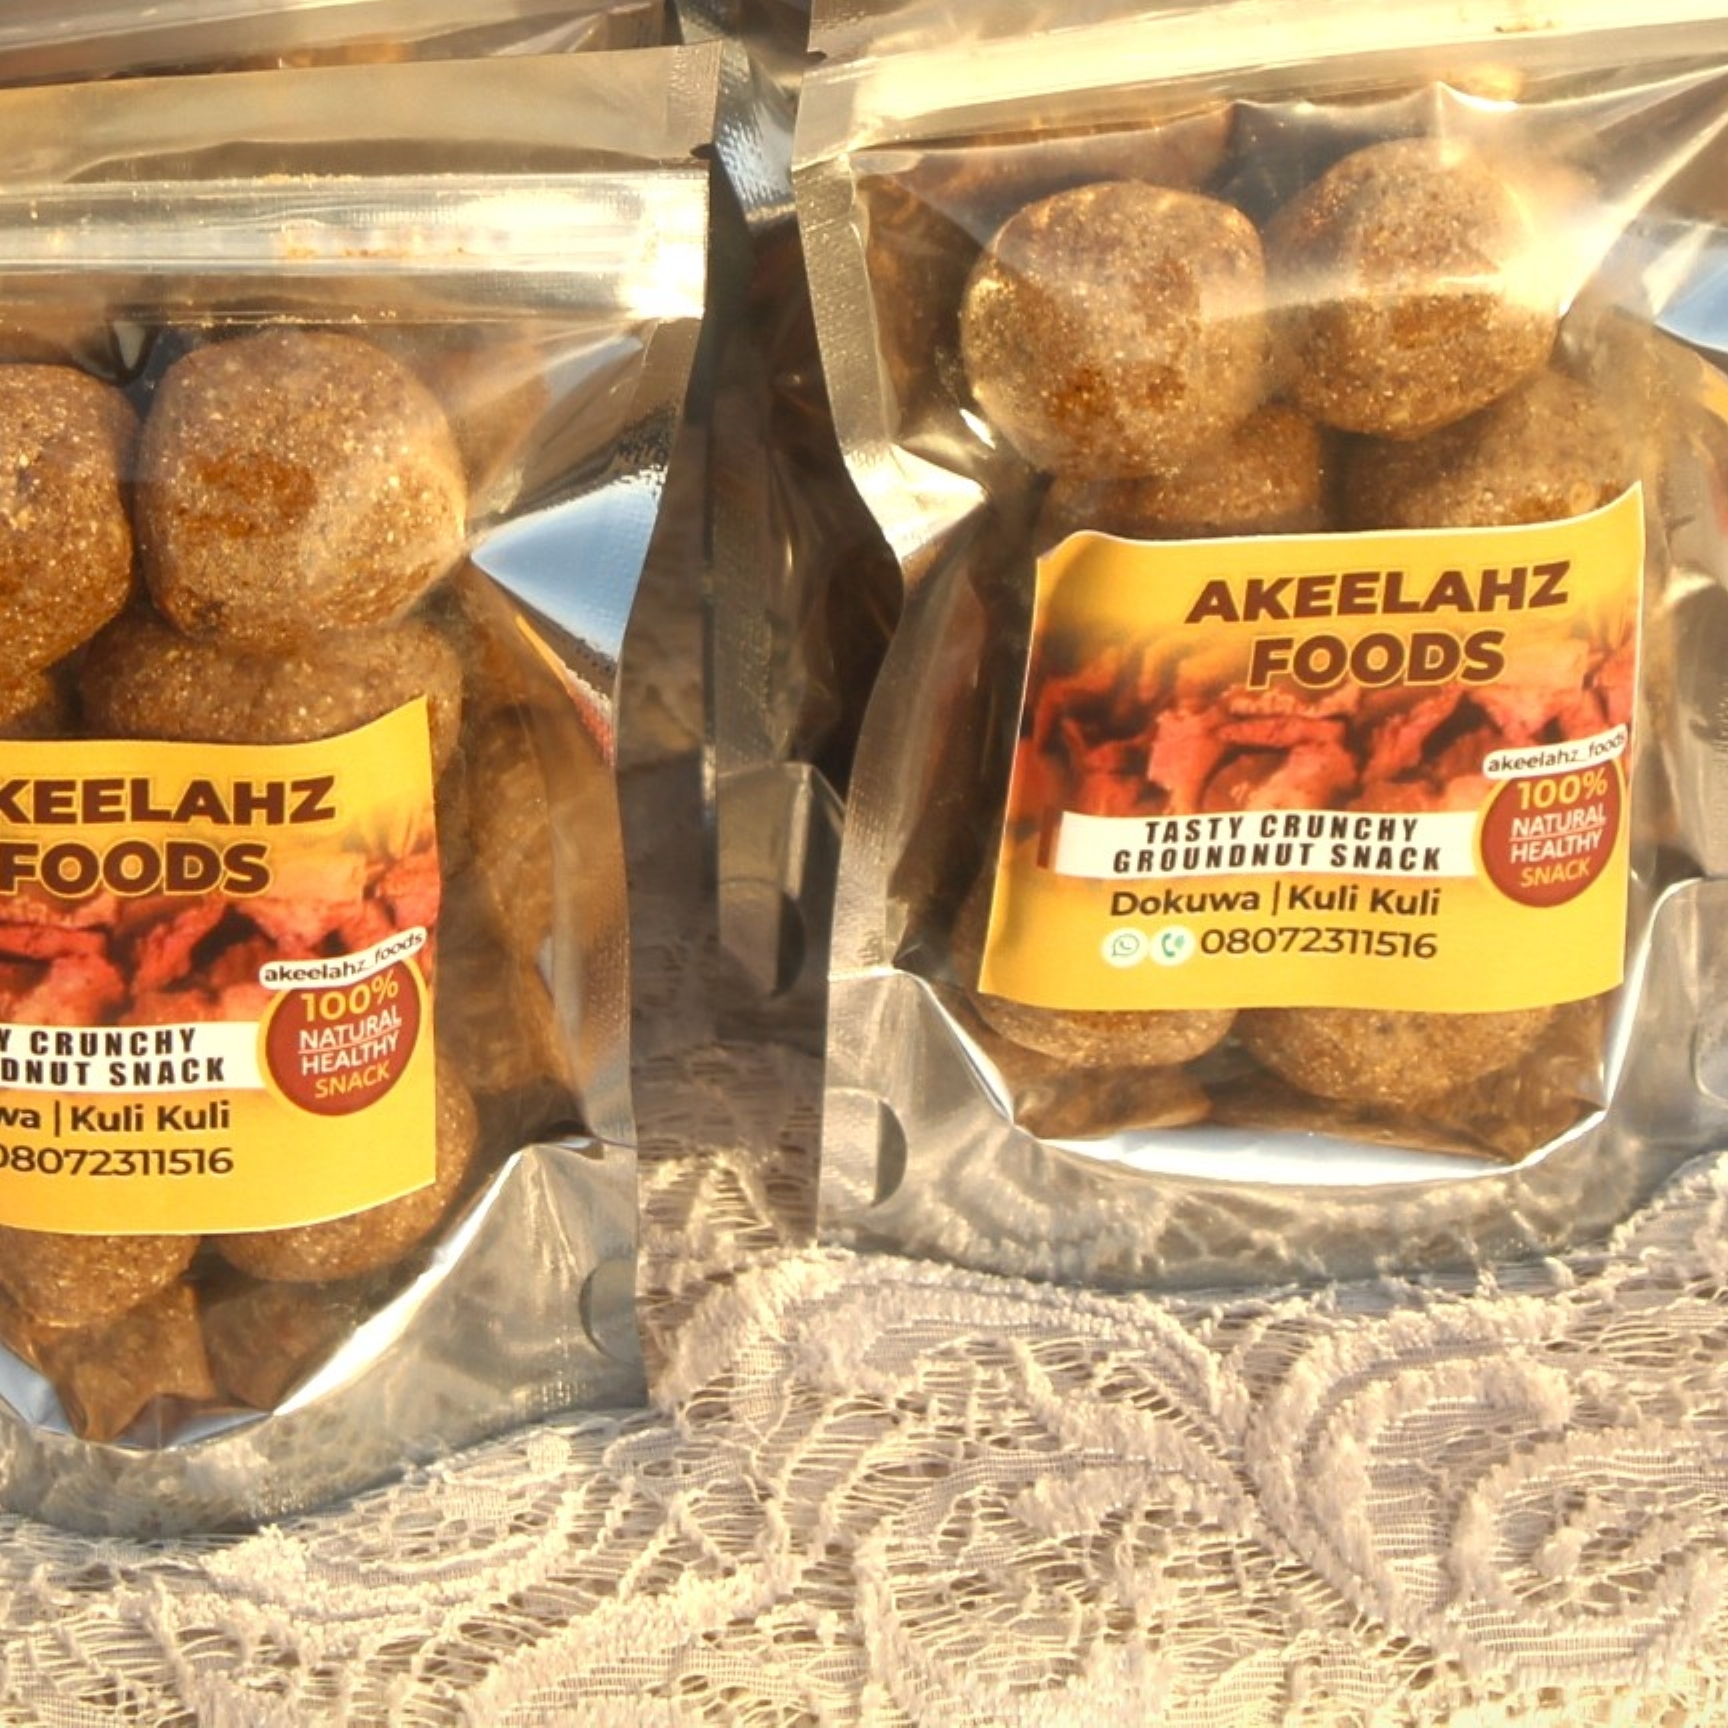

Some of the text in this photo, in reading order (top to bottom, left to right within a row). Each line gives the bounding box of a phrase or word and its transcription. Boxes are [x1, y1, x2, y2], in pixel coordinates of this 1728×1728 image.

[1184, 559, 1572, 624] AKEELAHZ
[1247, 629, 1507, 691] FOODS
[1517, 767, 1608, 811] 100%
[1145, 814, 1418, 844] TASTY CRUNCHY
[1510, 803, 1607, 838] NATURAL
[1113, 843, 1442, 873] GROUNDNUT SNACK
[1510, 829, 1604, 864] HEALTHY
[1521, 857, 1591, 888] SNACK
[1110, 889, 1261, 917] Dokuwa
[1288, 884, 1359, 911] Kuli
[1369, 887, 1442, 916] Kuli
[1200, 927, 1439, 959] 08072311516
[300, 969, 400, 1022] 100%
[30, 1027, 196, 1057] CRUNCHY
[298, 1005, 403, 1051] NATURAL
[301, 1030, 400, 1076] HEALTHY
[109, 1056, 226, 1086] SNACK
[314, 1061, 391, 1098] SNACK
[71, 1104, 144, 1132] Kuli
[157, 1100, 231, 1132] Kuli
